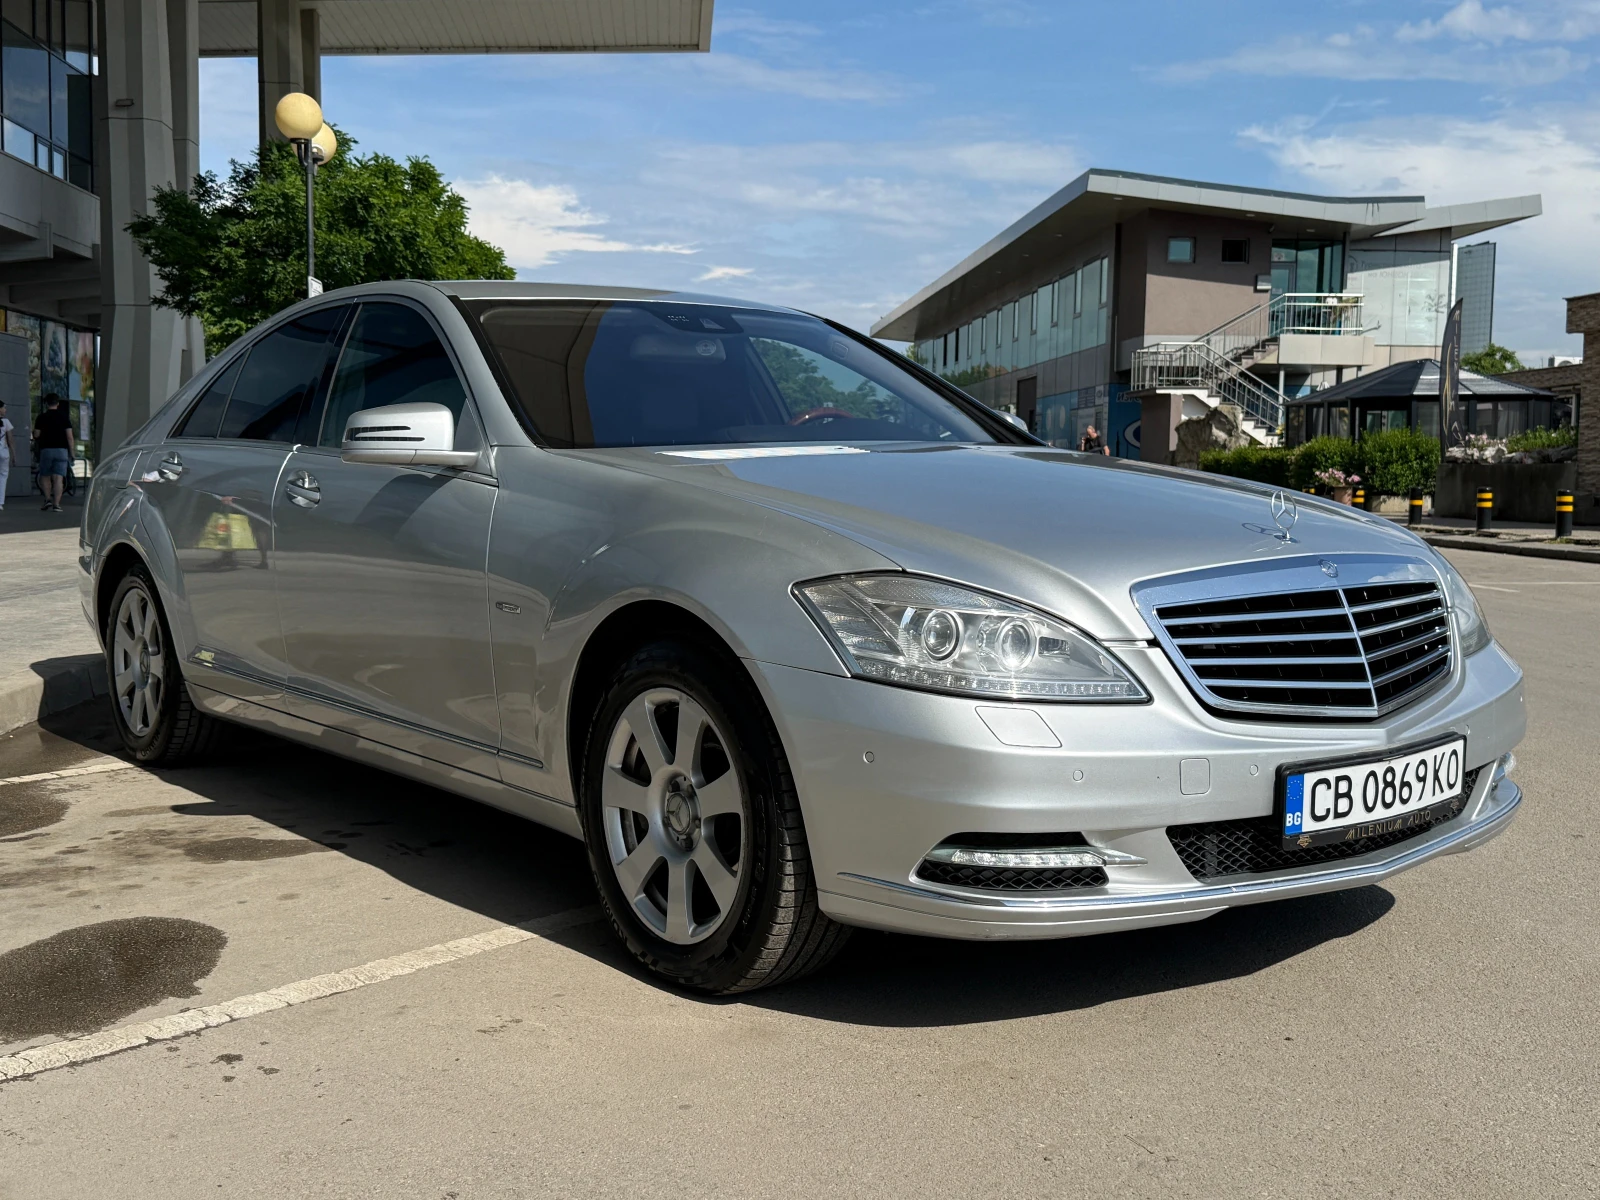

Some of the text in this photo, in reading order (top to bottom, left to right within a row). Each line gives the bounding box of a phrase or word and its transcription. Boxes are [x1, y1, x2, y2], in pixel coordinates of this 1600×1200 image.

[1362, 758, 1428, 813] 0869
[1286, 811, 1302, 827] BG
[1345, 810, 1431, 839] MILENIUM AUTO
